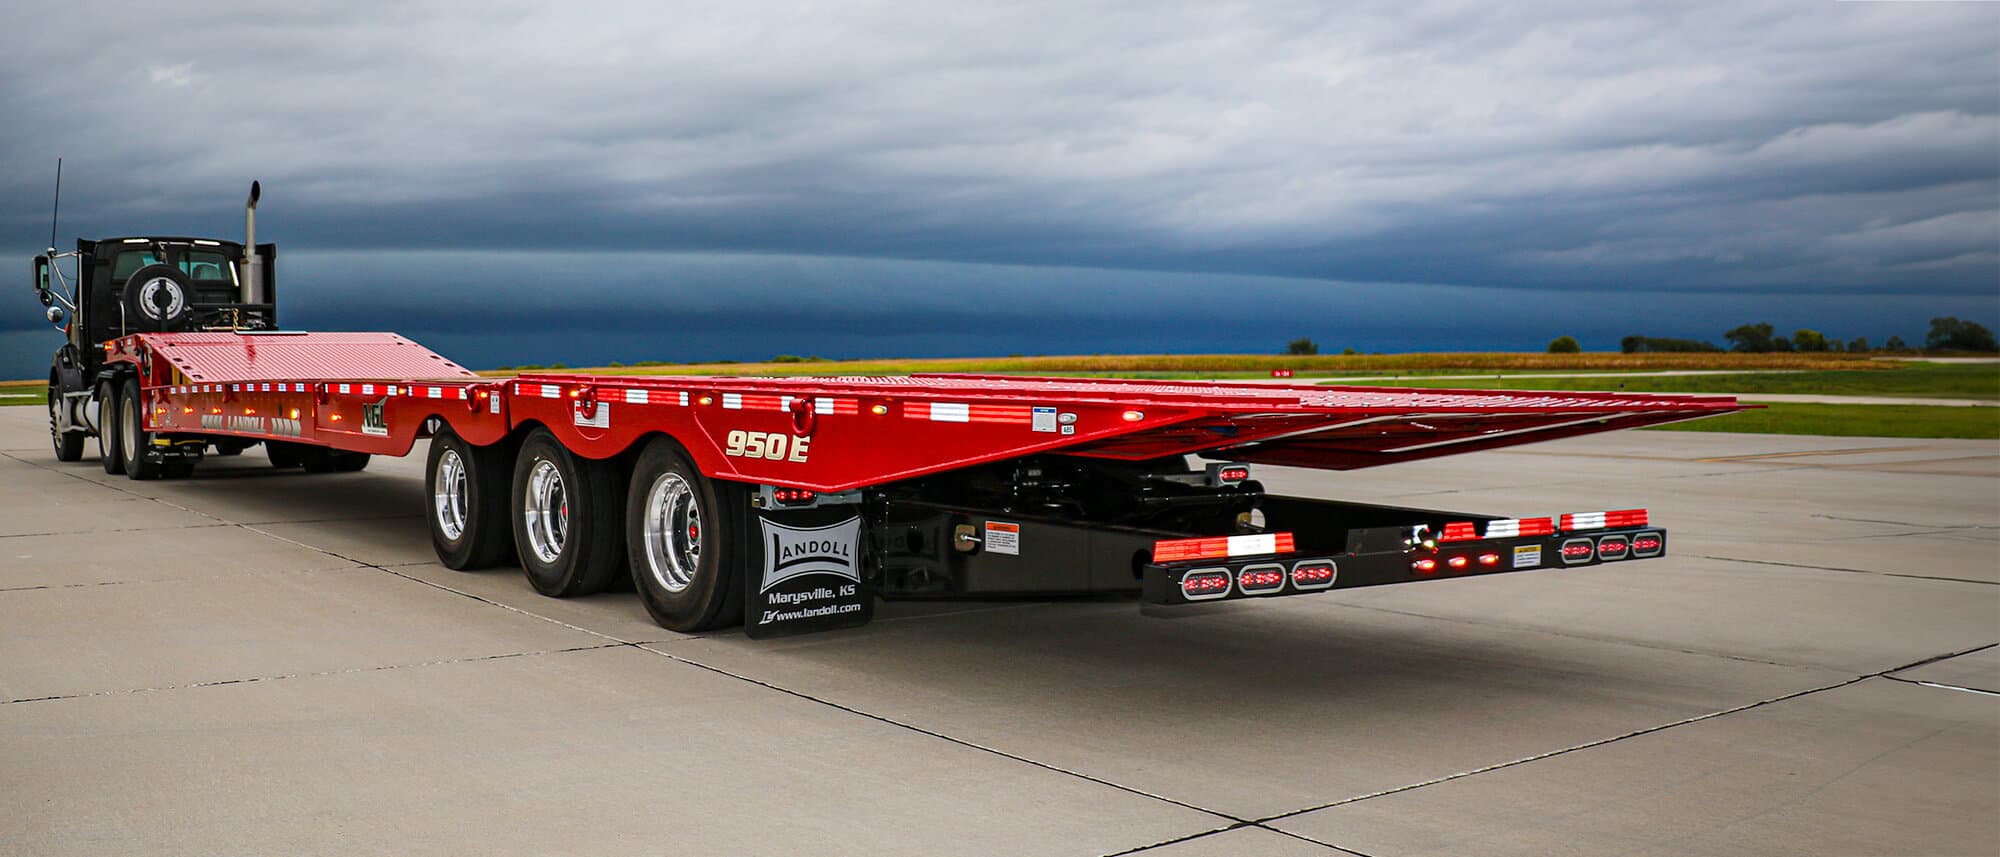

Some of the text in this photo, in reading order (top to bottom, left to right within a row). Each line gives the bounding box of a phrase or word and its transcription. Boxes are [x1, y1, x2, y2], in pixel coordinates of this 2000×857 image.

[228, 416, 265, 433] LANDOLL
[773, 533, 850, 572] LANDOLL
[768, 584, 856, 605] Marysville, KS
[776, 603, 861, 621] www.landoll.com
